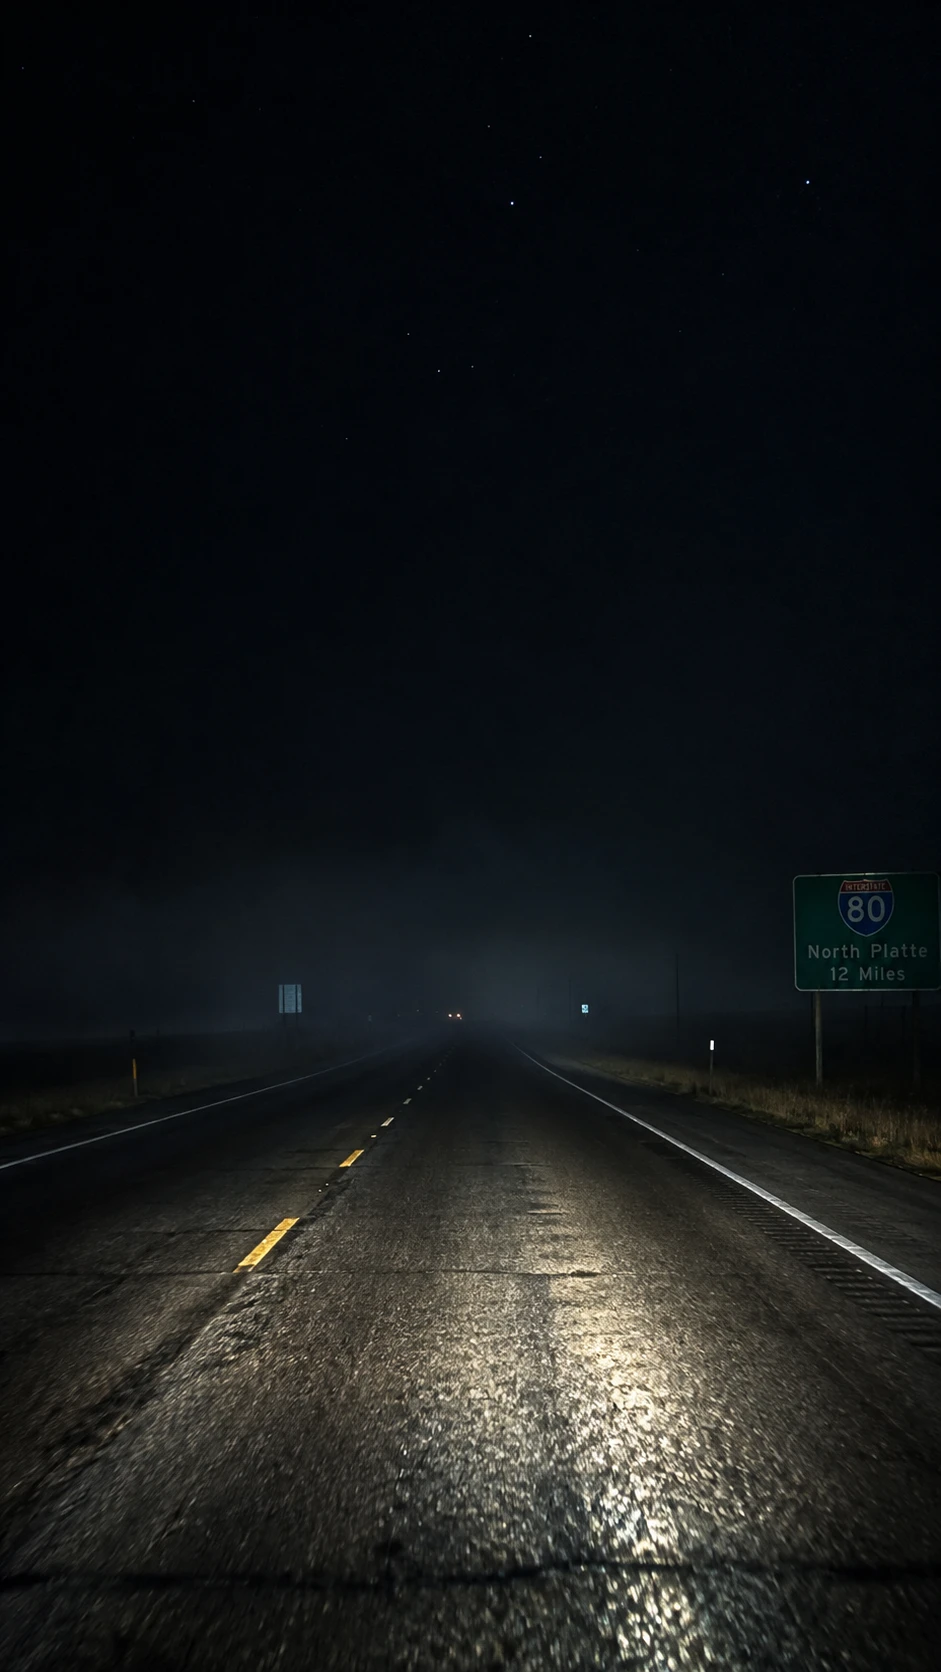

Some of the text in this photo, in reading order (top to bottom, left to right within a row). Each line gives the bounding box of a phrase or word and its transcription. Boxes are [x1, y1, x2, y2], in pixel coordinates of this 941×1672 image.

[847, 895, 886, 923] 80
[808, 943, 928, 959] North Platte
[830, 966, 906, 981] 12 Miles
